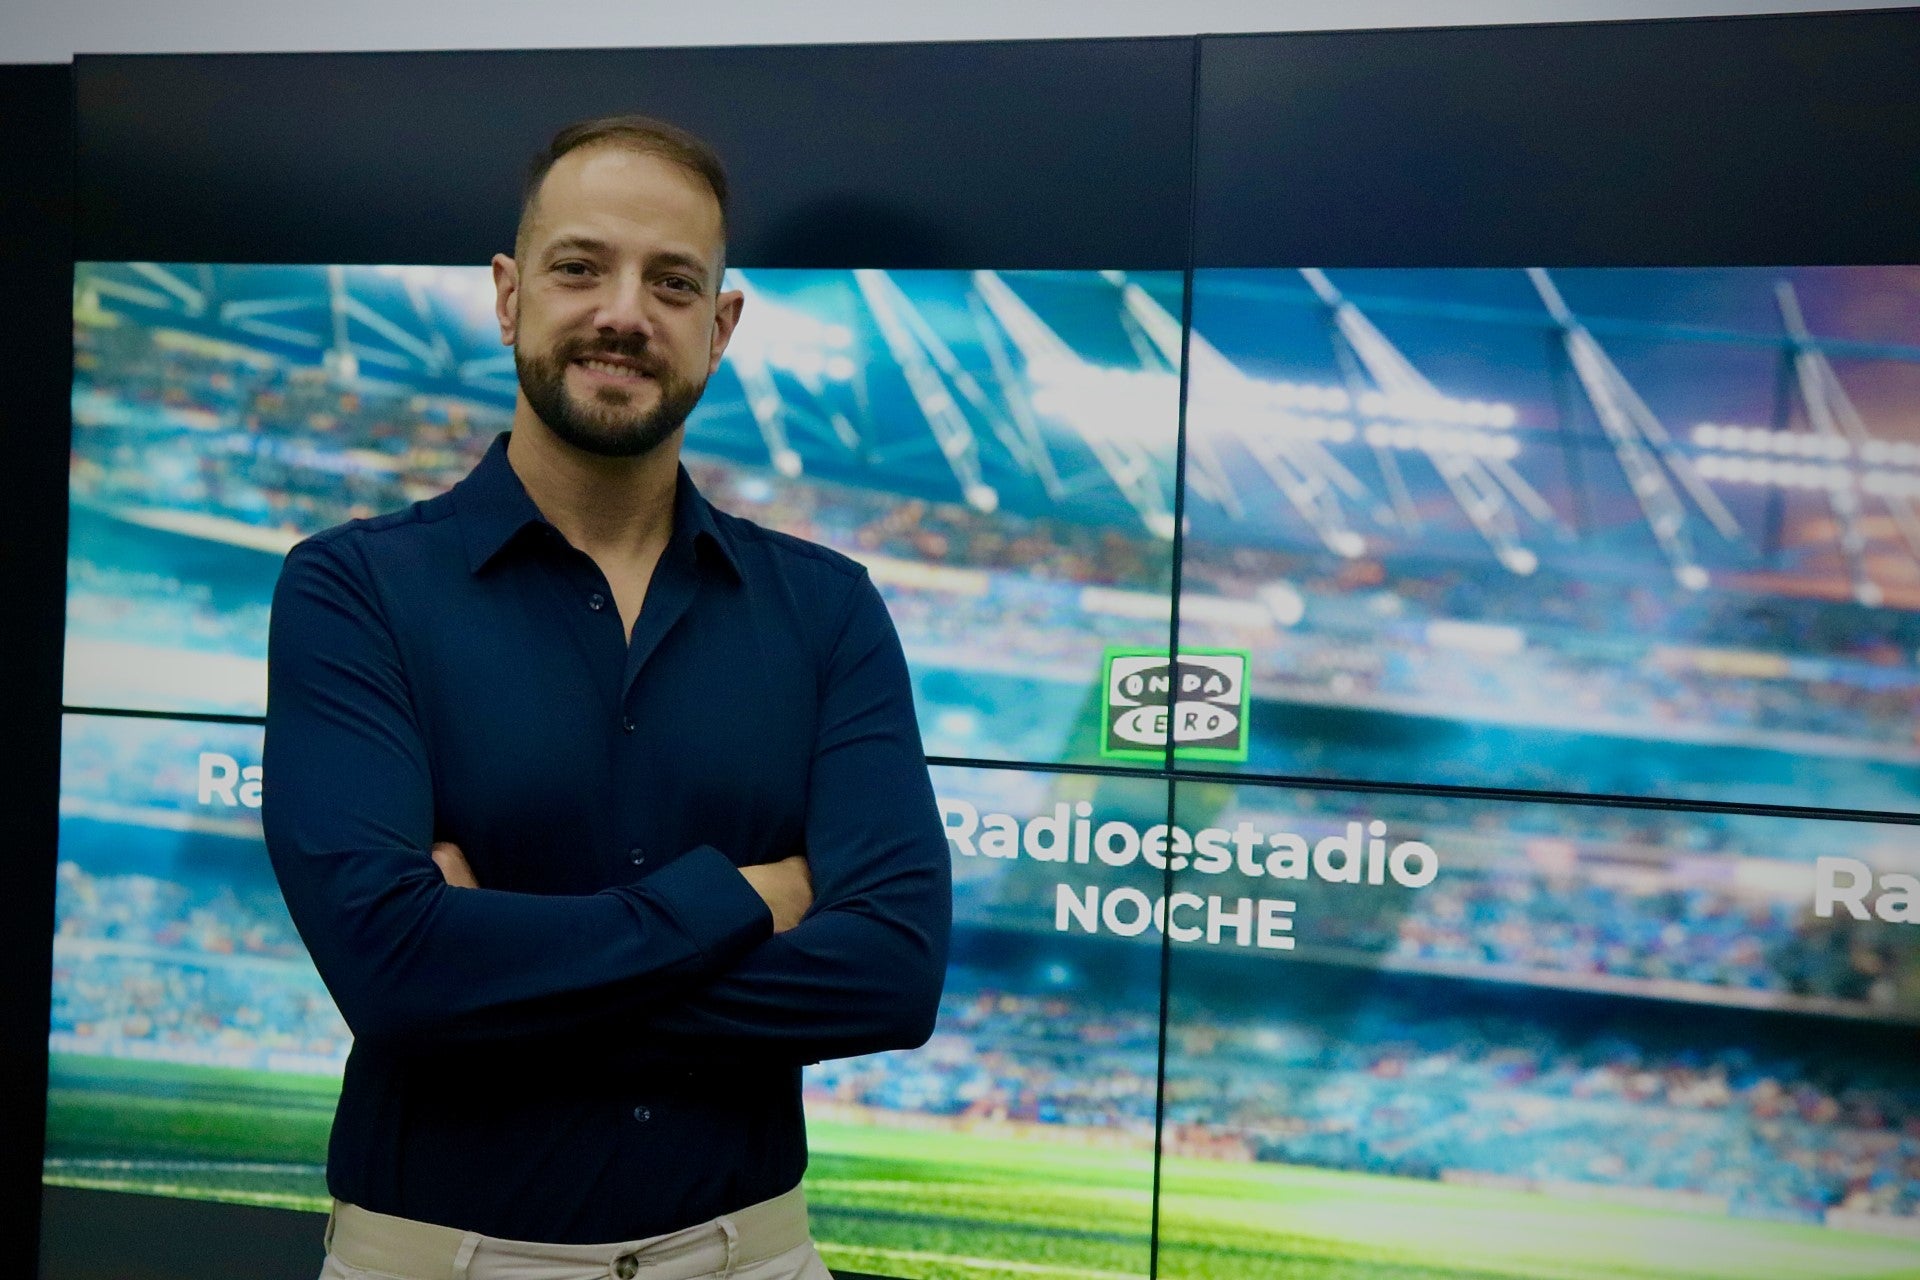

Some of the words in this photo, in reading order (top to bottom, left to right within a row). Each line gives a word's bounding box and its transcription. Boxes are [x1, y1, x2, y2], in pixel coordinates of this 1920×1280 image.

[1126, 674, 1223, 696] ONDA
[1132, 712, 1220, 733] CERO
[937, 797, 1439, 888] Radioestadio
[1055, 883, 1297, 950] NOCHE
